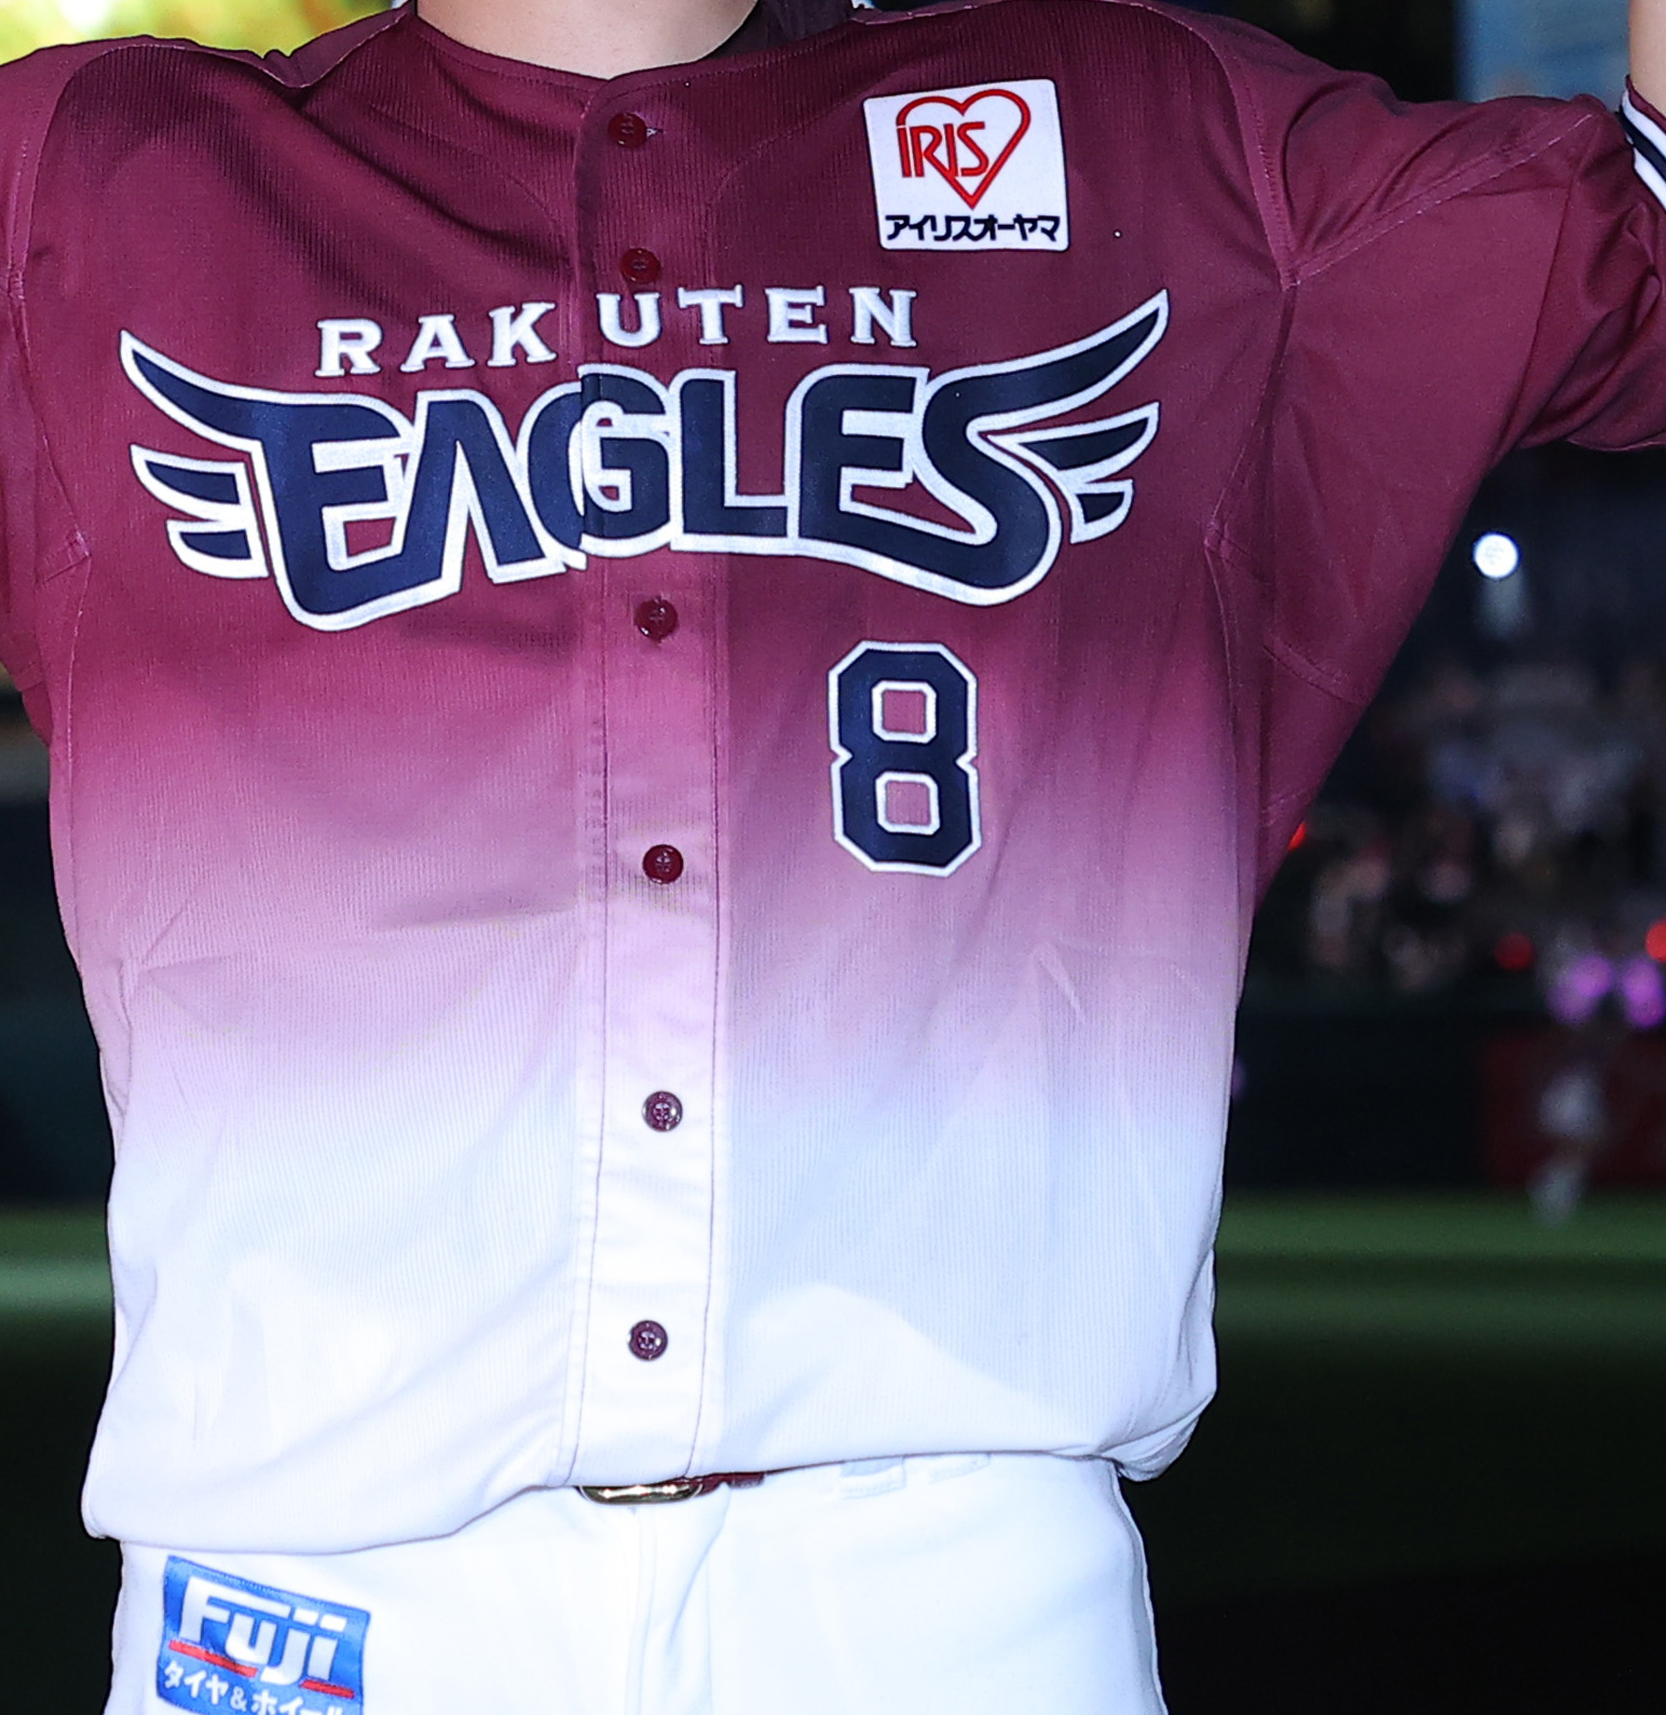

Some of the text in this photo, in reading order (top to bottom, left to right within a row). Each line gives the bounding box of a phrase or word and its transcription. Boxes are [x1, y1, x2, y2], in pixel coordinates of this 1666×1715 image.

[896, 120, 990, 178] IRIS
[884, 212, 1061, 242] アイリスオーヤマ
[314, 285, 919, 378] RAKUTEN
[193, 331, 1113, 632] EAGLES
[828, 639, 982, 878] 8
[178, 1575, 348, 1686] Fuji
